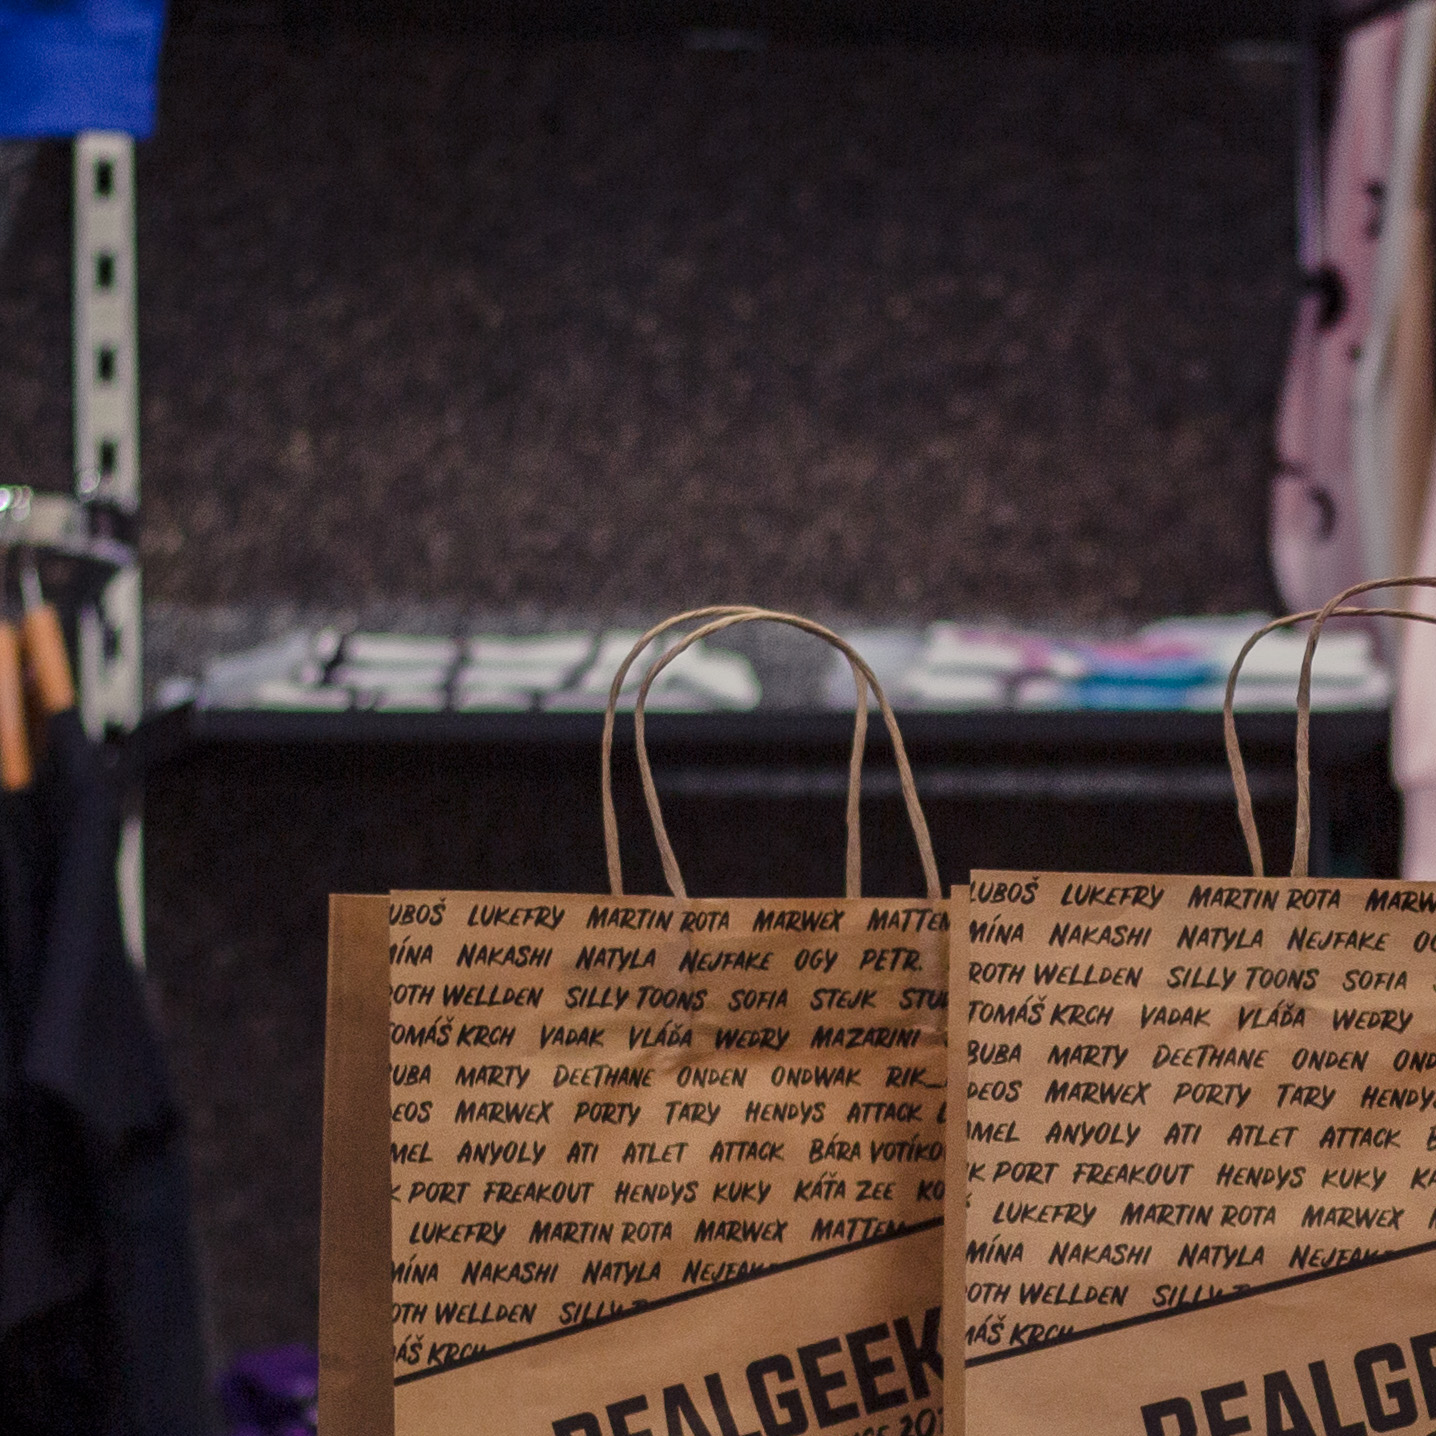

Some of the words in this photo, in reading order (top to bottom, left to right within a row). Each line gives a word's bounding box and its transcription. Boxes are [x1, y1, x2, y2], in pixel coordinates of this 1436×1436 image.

[468, 905, 565, 930] LUKEFRY
[586, 906, 673, 931] MARTIN
[680, 911, 729, 933] ROTA
[753, 909, 845, 932] MARWEX
[1049, 923, 1151, 947] NAKASHI
[1177, 925, 1263, 951] NATYLA
[1287, 927, 1388, 951] NEJFAKE
[456, 943, 552, 968] NAKASHI
[575, 946, 656, 972] NATYLA
[679, 949, 773, 974] NEJFAKE
[794, 949, 838, 973] OGY
[1034, 964, 1143, 987] WELLDEN
[1167, 966, 1236, 991] SILLY
[1246, 967, 1319, 990] TOONS
[1343, 970, 1407, 991] SOFIA
[456, 1024, 516, 1047] KRCH
[540, 1025, 605, 1049] VADAK
[715, 1027, 790, 1051] WEDRY
[811, 1025, 921, 1049] MAZARINI
[1048, 1045, 1128, 1069] MARTY
[1152, 1044, 1267, 1069] DEETHANE
[1292, 1048, 1369, 1071] ONDEN
[455, 1100, 553, 1124] MARWEX
[574, 1101, 641, 1126] PORTY
[666, 1101, 720, 1125] TARY
[745, 1101, 825, 1124] HENDYS
[847, 1102, 922, 1123] ATTACK
[1045, 1121, 1140, 1147] ANYOLY
[1164, 1122, 1201, 1144] ATI
[1227, 1124, 1298, 1147] ATLET
[1319, 1126, 1400, 1148] ATTACK
[408, 1182, 470, 1204] PORT
[483, 1181, 594, 1204] FREAKOUT
[615, 1181, 698, 1205] HENDYS
[713, 1181, 771, 1204] KUKY
[856, 1180, 895, 1201] ZEE
